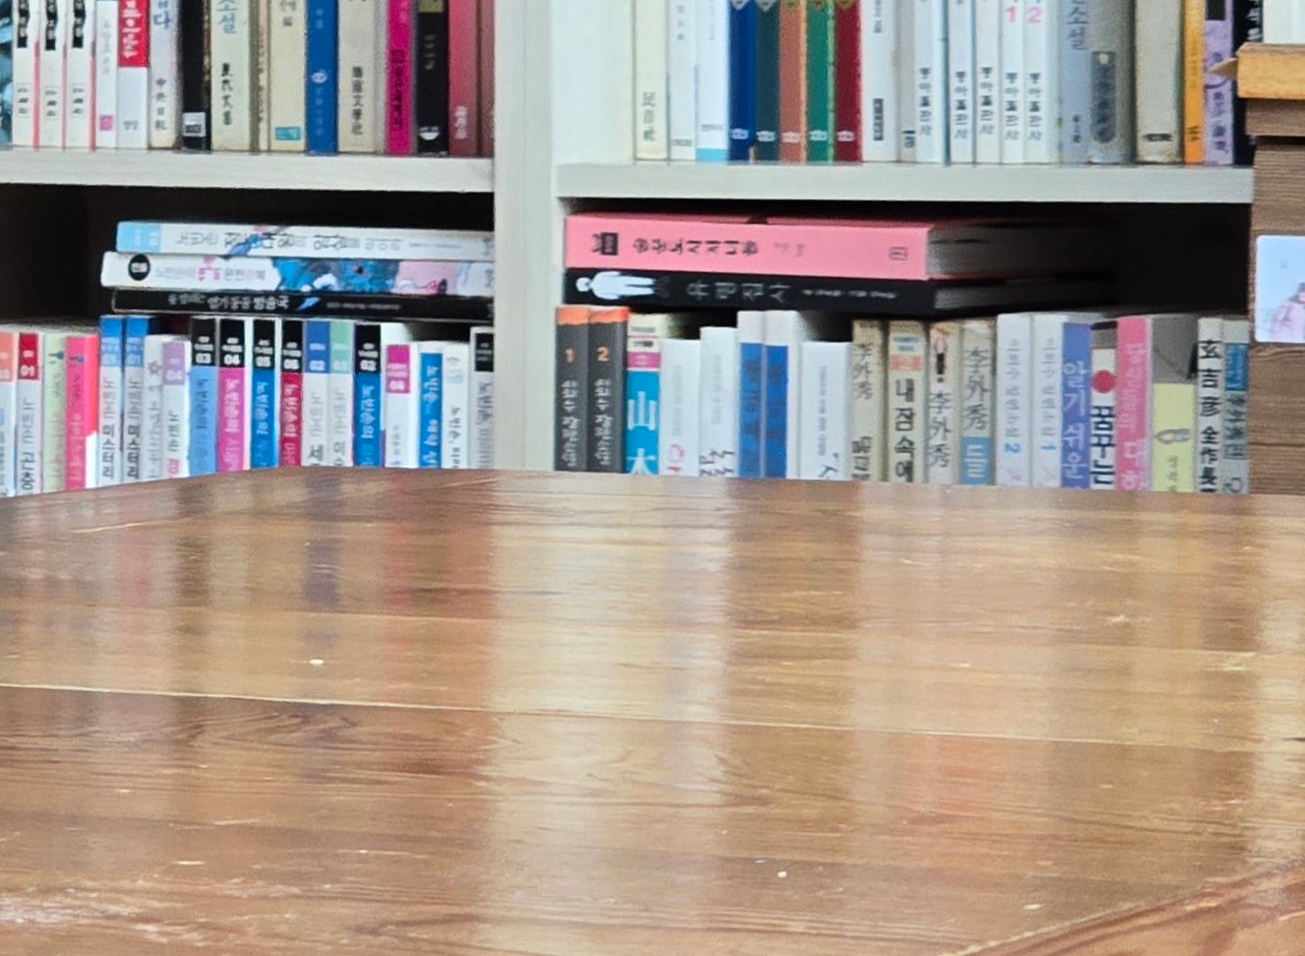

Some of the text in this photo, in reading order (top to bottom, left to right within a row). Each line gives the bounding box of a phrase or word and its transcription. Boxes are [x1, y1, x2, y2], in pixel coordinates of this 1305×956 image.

[1005, 5, 1018, 23] 1
[1027, 6, 1043, 24] 2
[565, 348, 575, 362] 1
[597, 346, 610, 362] 2
[961, 346, 988, 430] 李外秀
[1063, 360, 1087, 479] 알기 쉬운
[928, 390, 952, 468] 李外秀
[1004, 442, 1021, 455] 2
